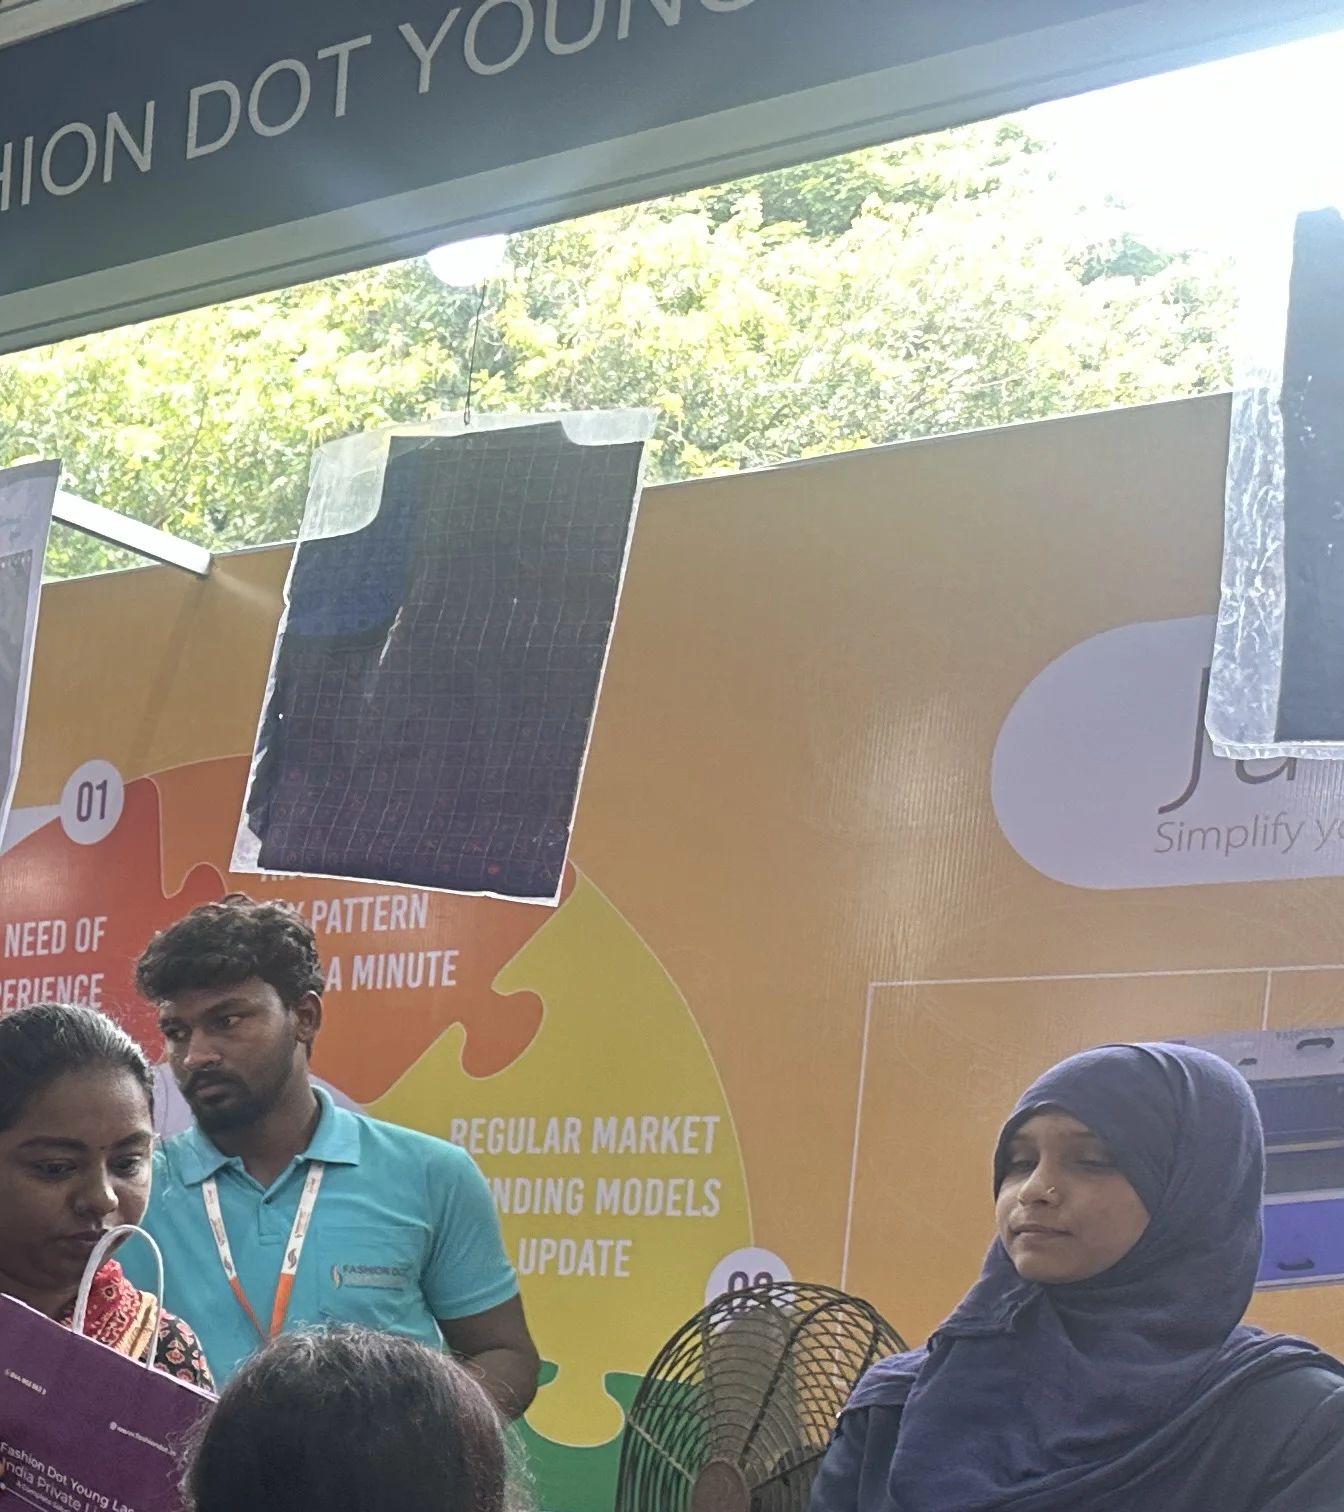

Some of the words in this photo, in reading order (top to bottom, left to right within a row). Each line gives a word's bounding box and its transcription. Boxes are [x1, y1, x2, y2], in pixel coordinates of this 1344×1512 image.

[186, 34, 372, 159] DOT
[398, 0, 756, 94] YOUN
[76, 780, 107, 822] 01
[1154, 811, 1306, 856] Simplify
[312, 893, 429, 934] PATTERN
[4, 920, 67, 957] NEED
[75, 916, 107, 953] OF
[325, 956, 342, 992] A
[351, 950, 459, 991] MINUTE
[450, 1116, 582, 1154] REGULAR
[592, 1115, 720, 1154] MARKET
[490, 1177, 585, 1215] NDING
[595, 1178, 721, 1217] MODELS
[518, 1237, 632, 1277] UPDATE
[0, 1441, 45, 1473] Fashion
[47, 1466, 68, 1486] Dot
[70, 1477, 109, 1509] Young
[2, 1457, 34, 1484] India
[37, 1476, 82, 1511] Private
